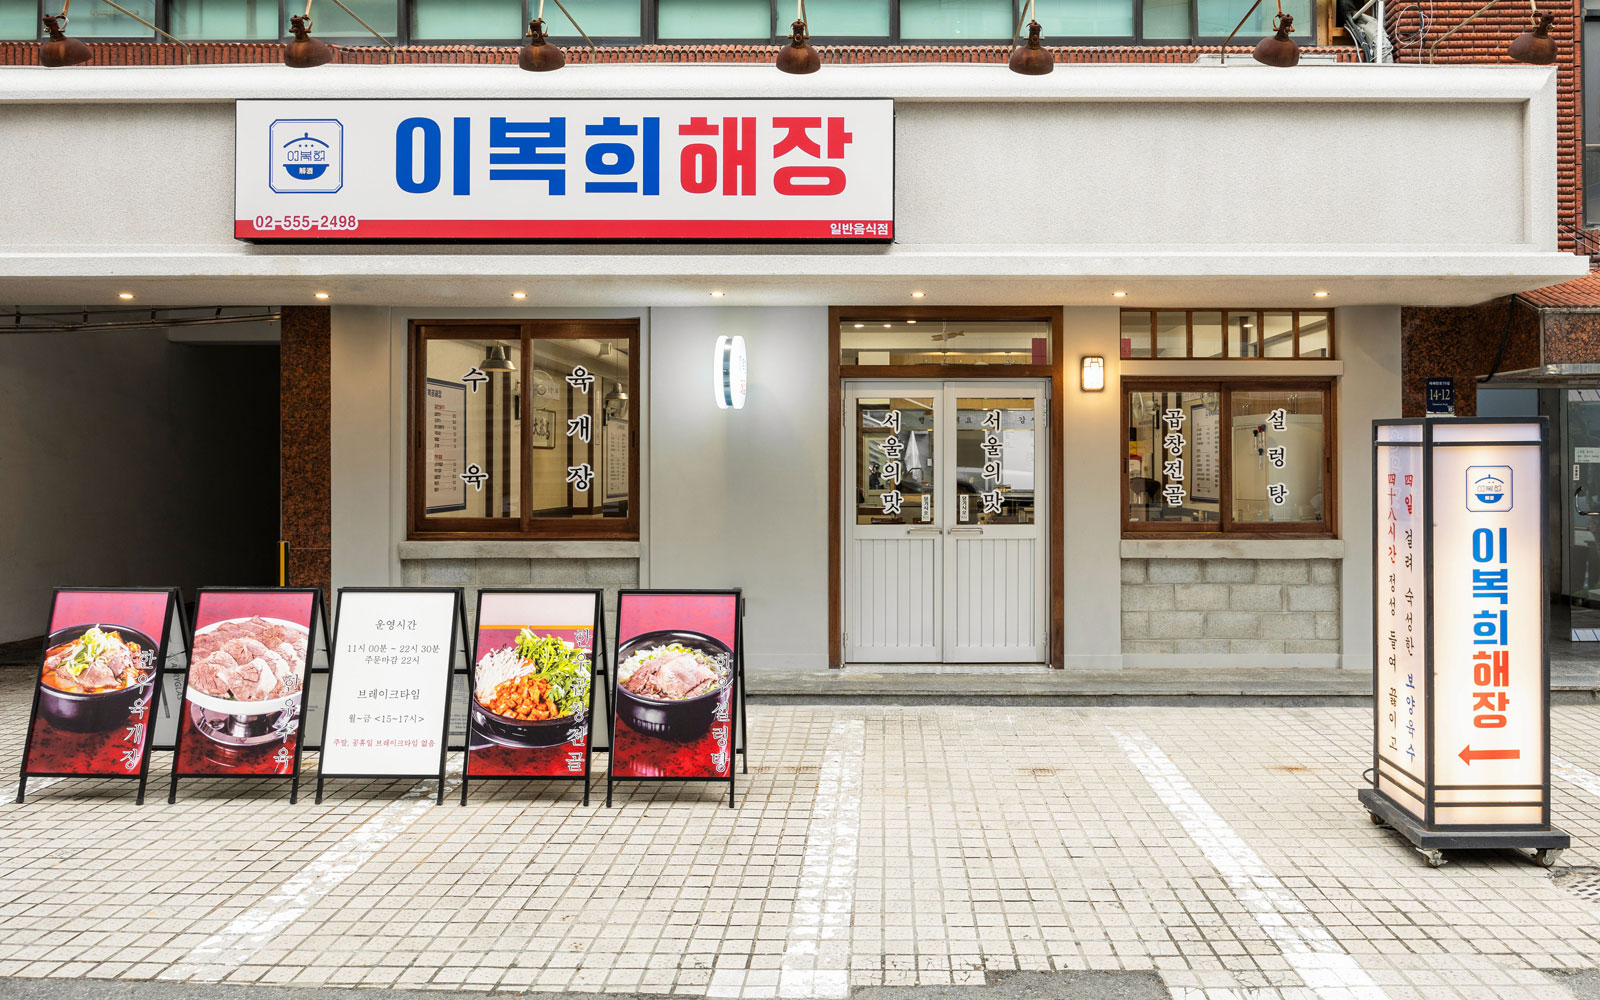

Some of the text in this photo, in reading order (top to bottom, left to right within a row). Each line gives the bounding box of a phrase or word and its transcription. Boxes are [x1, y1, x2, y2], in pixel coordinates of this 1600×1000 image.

[287, 150, 325, 161] 이복희
[396, 117, 853, 196] 이복희해장
[254, 215, 357, 229] 02-555-2498
[829, 222, 889, 236] 일반음식점
[1430, 389, 1451, 401] 14-12
[461, 367, 489, 491] 수육
[566, 366, 595, 491] 육개장
[1162, 408, 1187, 506] 곱창전골
[1266, 407, 1289, 506] 설렁탕
[1404, 528, 1413, 573] 걸려
[1388, 572, 1397, 617] 정성
[1404, 587, 1415, 657] 숙성한
[347, 644, 366, 653] 11시
[368, 644, 388, 654] 00분
[399, 644, 418, 654] 22시
[420, 644, 440, 654] 30분
[375, 619, 417, 631] 운영시간
[1388, 630, 1398, 673] 들여
[1472, 527, 1510, 729] 이복희해장
[364, 655, 420, 665] 주문마감 22시
[119, 649, 157, 770] 한우육개장
[272, 673, 302, 769] 한우수육
[357, 688, 421, 700] 브레이크타임
[710, 651, 734, 773] 한우설렁탕
[1388, 687, 1398, 752] 끓이고
[1405, 673, 1416, 764] 보양육수
[352, 738, 373, 747] 공휴일
[376, 738, 418, 748] 브레이크타임
[421, 738, 436, 748] 없음
